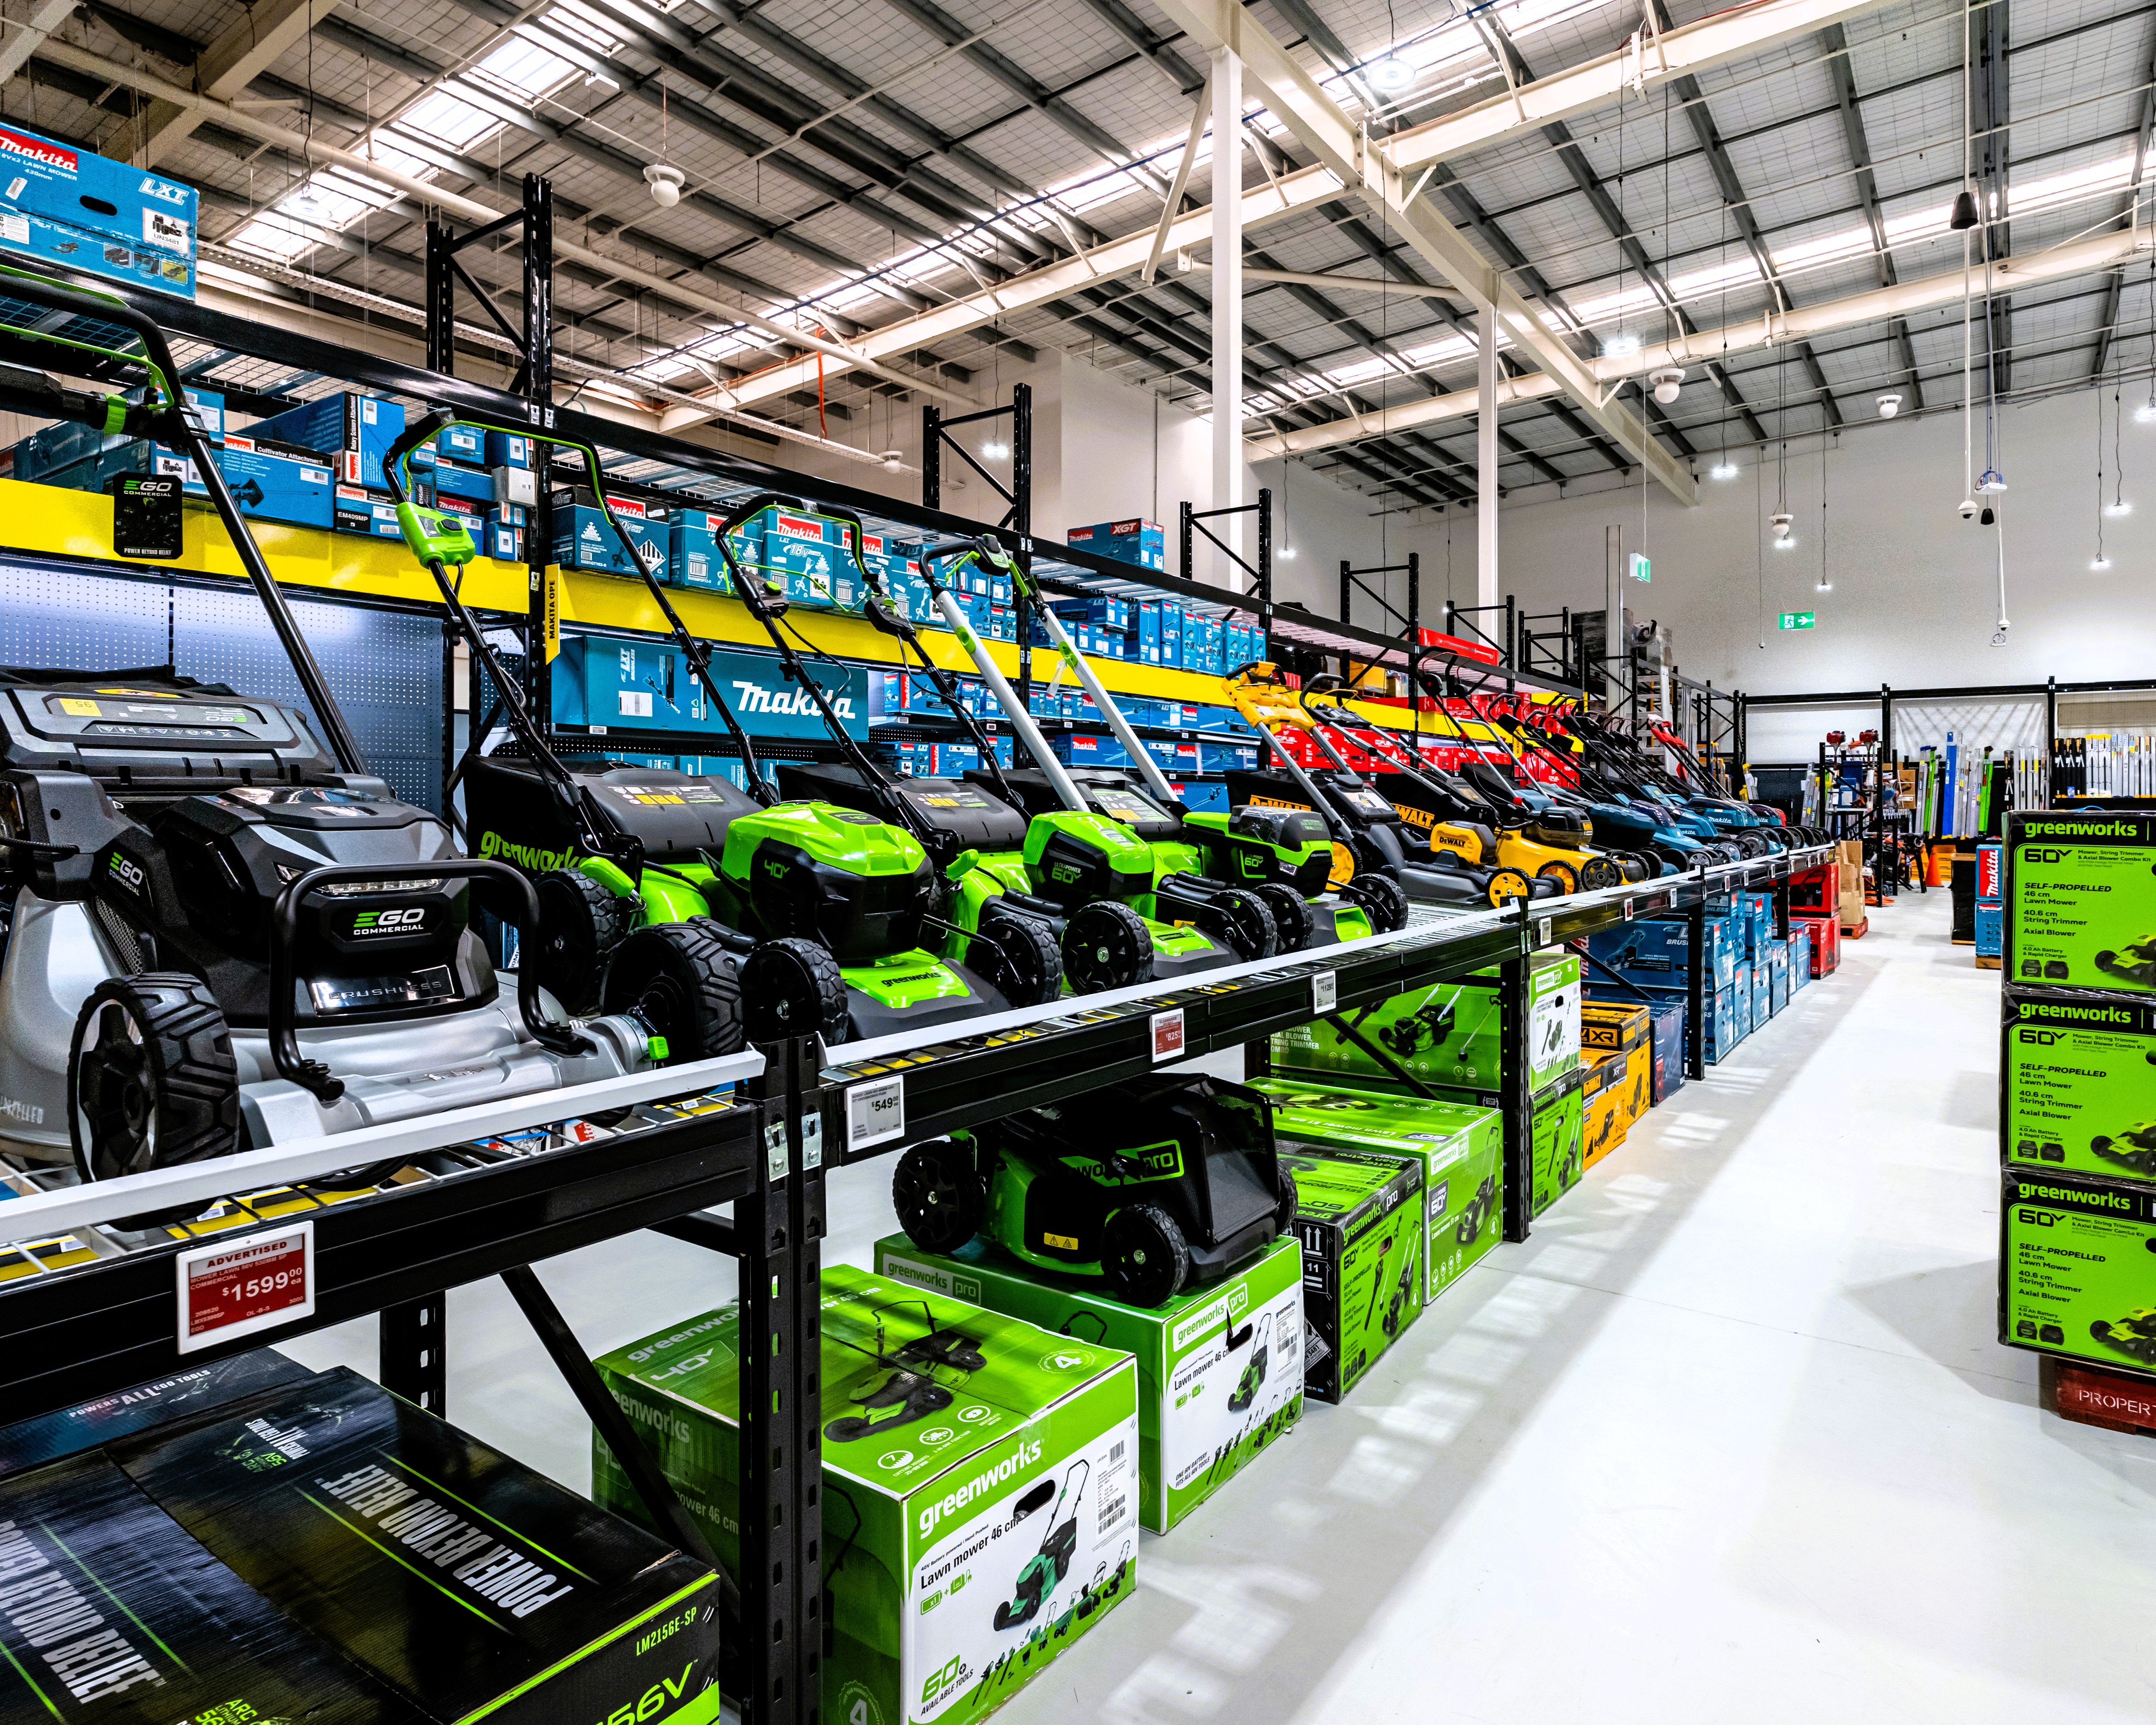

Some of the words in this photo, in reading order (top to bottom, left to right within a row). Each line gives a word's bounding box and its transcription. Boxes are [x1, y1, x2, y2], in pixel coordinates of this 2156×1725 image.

[0, 135, 78, 173] Makita
[23, 160, 47, 171] LAWN
[48, 168, 77, 181] MOWER
[25, 169, 53, 181] 430mm
[138, 177, 190, 206] LXT
[154, 233, 179, 245] UN3481
[257, 446, 288, 458] Cultivator
[289, 452, 323, 466] Attachment
[123, 480, 172, 492] EGO
[338, 511, 368, 522] EM409MP
[439, 501, 472, 514] Makita
[778, 523, 821, 541] Makita
[1113, 522, 1137, 534] XGT
[1069, 533, 1094, 543] Makita
[621, 647, 630, 672] LXT
[1182, 709, 1197, 717] Makita
[1072, 740, 1097, 751] Makita
[1177, 749, 1197, 757] Makita
[2024, 820, 2137, 838] greenworks
[1245, 858, 1263, 868] 60V
[2024, 848, 2073, 863] 60V
[110, 851, 144, 885] EGO
[1051, 867, 1082, 884] 60V
[1054, 861, 1081, 874] ULTRAPOWER
[1986, 850, 1999, 897] Makita
[109, 868, 140, 897] COMMERCIAL
[2024, 882, 2112, 892] SELF-PROPELLED
[354, 908, 424, 928] EGO
[2023, 916, 2050, 925] String
[2051, 918, 2088, 926] Trimmer
[353, 924, 424, 935] COMMERCIAL
[2046, 929, 2076, 937] Blower
[881, 971, 942, 987] greenworks
[1537, 974, 1553, 990] greenworks
[329, 980, 442, 1000] BRUSHLESS
[1159, 1016, 1177, 1025] CLEARANCE
[2019, 1003, 2131, 1023] greenworks
[1166, 1030, 1178, 1042] $825
[1286, 1032, 1313, 1041] BLOWER,
[1290, 1040, 1319, 1050] TRIMMER
[1591, 1032, 1615, 1044] XR
[2019, 1029, 2068, 1046] 60V
[2019, 1063, 2107, 1078] SELF-PROPELLED
[1532, 1090, 1556, 1113] greenworks
[1360, 1160, 1401, 1168] Better
[1433, 1146, 1457, 1172] greenworks
[1459, 1139, 1468, 1153] pro
[1431, 1192, 1447, 1215] 60V
[2018, 1182, 2131, 1210] greenworks
[1344, 1203, 1381, 1247] greenworks
[1386, 1189, 1398, 1212] pro
[2018, 1208, 2068, 1228] 60V
[207, 1241, 287, 1268] ADVERTISED
[1343, 1245, 1360, 1271] 60V
[2019, 1242, 2106, 1263] SELF-PROPELLED
[190, 1272, 217, 1284] MOWER
[219, 1266, 239, 1275] LAWN
[255, 1256, 277, 1267] 530MM
[888, 1261, 947, 1290] greenworks
[1344, 1263, 1372, 1291] SELF-PROPELLED
[190, 1273, 238, 1290] COMMERCIAL
[222, 1271, 288, 1301] $1599
[289, 1267, 302, 1277] 00
[291, 1277, 301, 1285] ea
[289, 1295, 304, 1305] 3000
[1275, 1299, 1296, 1319] greenworks
[195, 1306, 219, 1318] 209520
[1178, 1302, 1225, 1345] greenworks
[1230, 1291, 1245, 1311] pro
[191, 1325, 204, 1333] EGO
[1174, 1375, 1192, 1391] Lawn
[1193, 1361, 1214, 1380] mower
[69, 1398, 119, 1419] POWERS
[120, 1387, 162, 1406] ALL
[155, 1380, 176, 1391] EGO
[175, 1369, 211, 1384] TOOLS
[978, 1412, 1001, 1427] BRUSHLESS
[951, 1430, 971, 1443] FUNCTION
[1191, 1451, 1208, 1466] BATTERY
[1198, 1456, 1210, 1469] TOOLS
[919, 1439, 1042, 1539] greenworks
[321, 1464, 419, 1518] RELIEF
[378, 1498, 494, 1568] BEYOND
[452, 1544, 574, 1618] POWER
[931, 1554, 946, 1566] Battery
[946, 1541, 963, 1557] powered
[965, 1534, 975, 1543] Hand
[921, 1562, 951, 1590] Lawn
[953, 1536, 989, 1568] mower
[635, 1606, 697, 1656] LM2156E-SP
[41, 1628, 160, 1705] RELIEF
[921, 1683, 956, 1716] AVAILABLE
[956, 1668, 974, 1689] TOOLS
[225, 1699, 258, 1721] ARC
